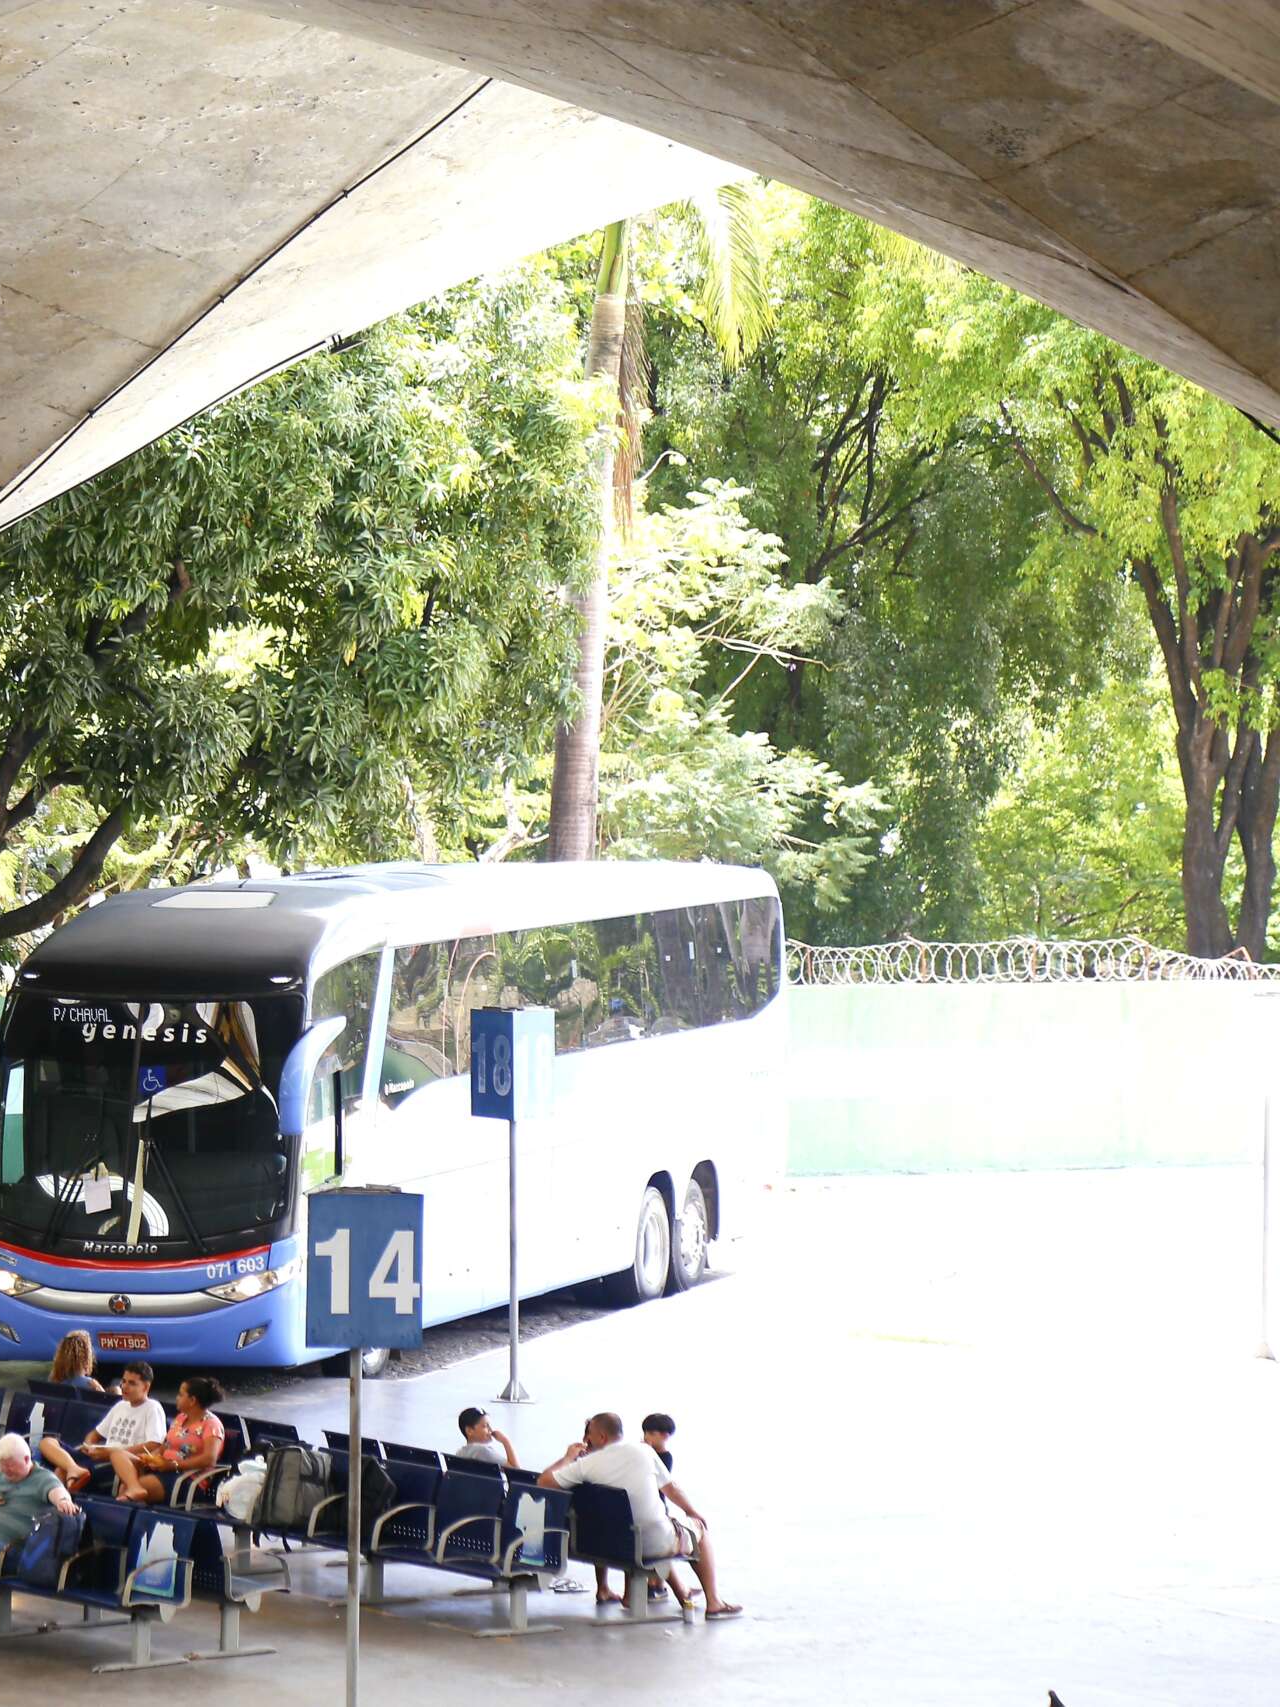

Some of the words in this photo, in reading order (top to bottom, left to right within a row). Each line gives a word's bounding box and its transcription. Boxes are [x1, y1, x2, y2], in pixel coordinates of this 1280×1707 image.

[70, 1008, 113, 1023] CHAVAL
[81, 1022, 208, 1044] genesis
[472, 1033, 512, 1097] 18
[83, 1241, 159, 1256] Marcopolo
[314, 1228, 421, 1315] 14
